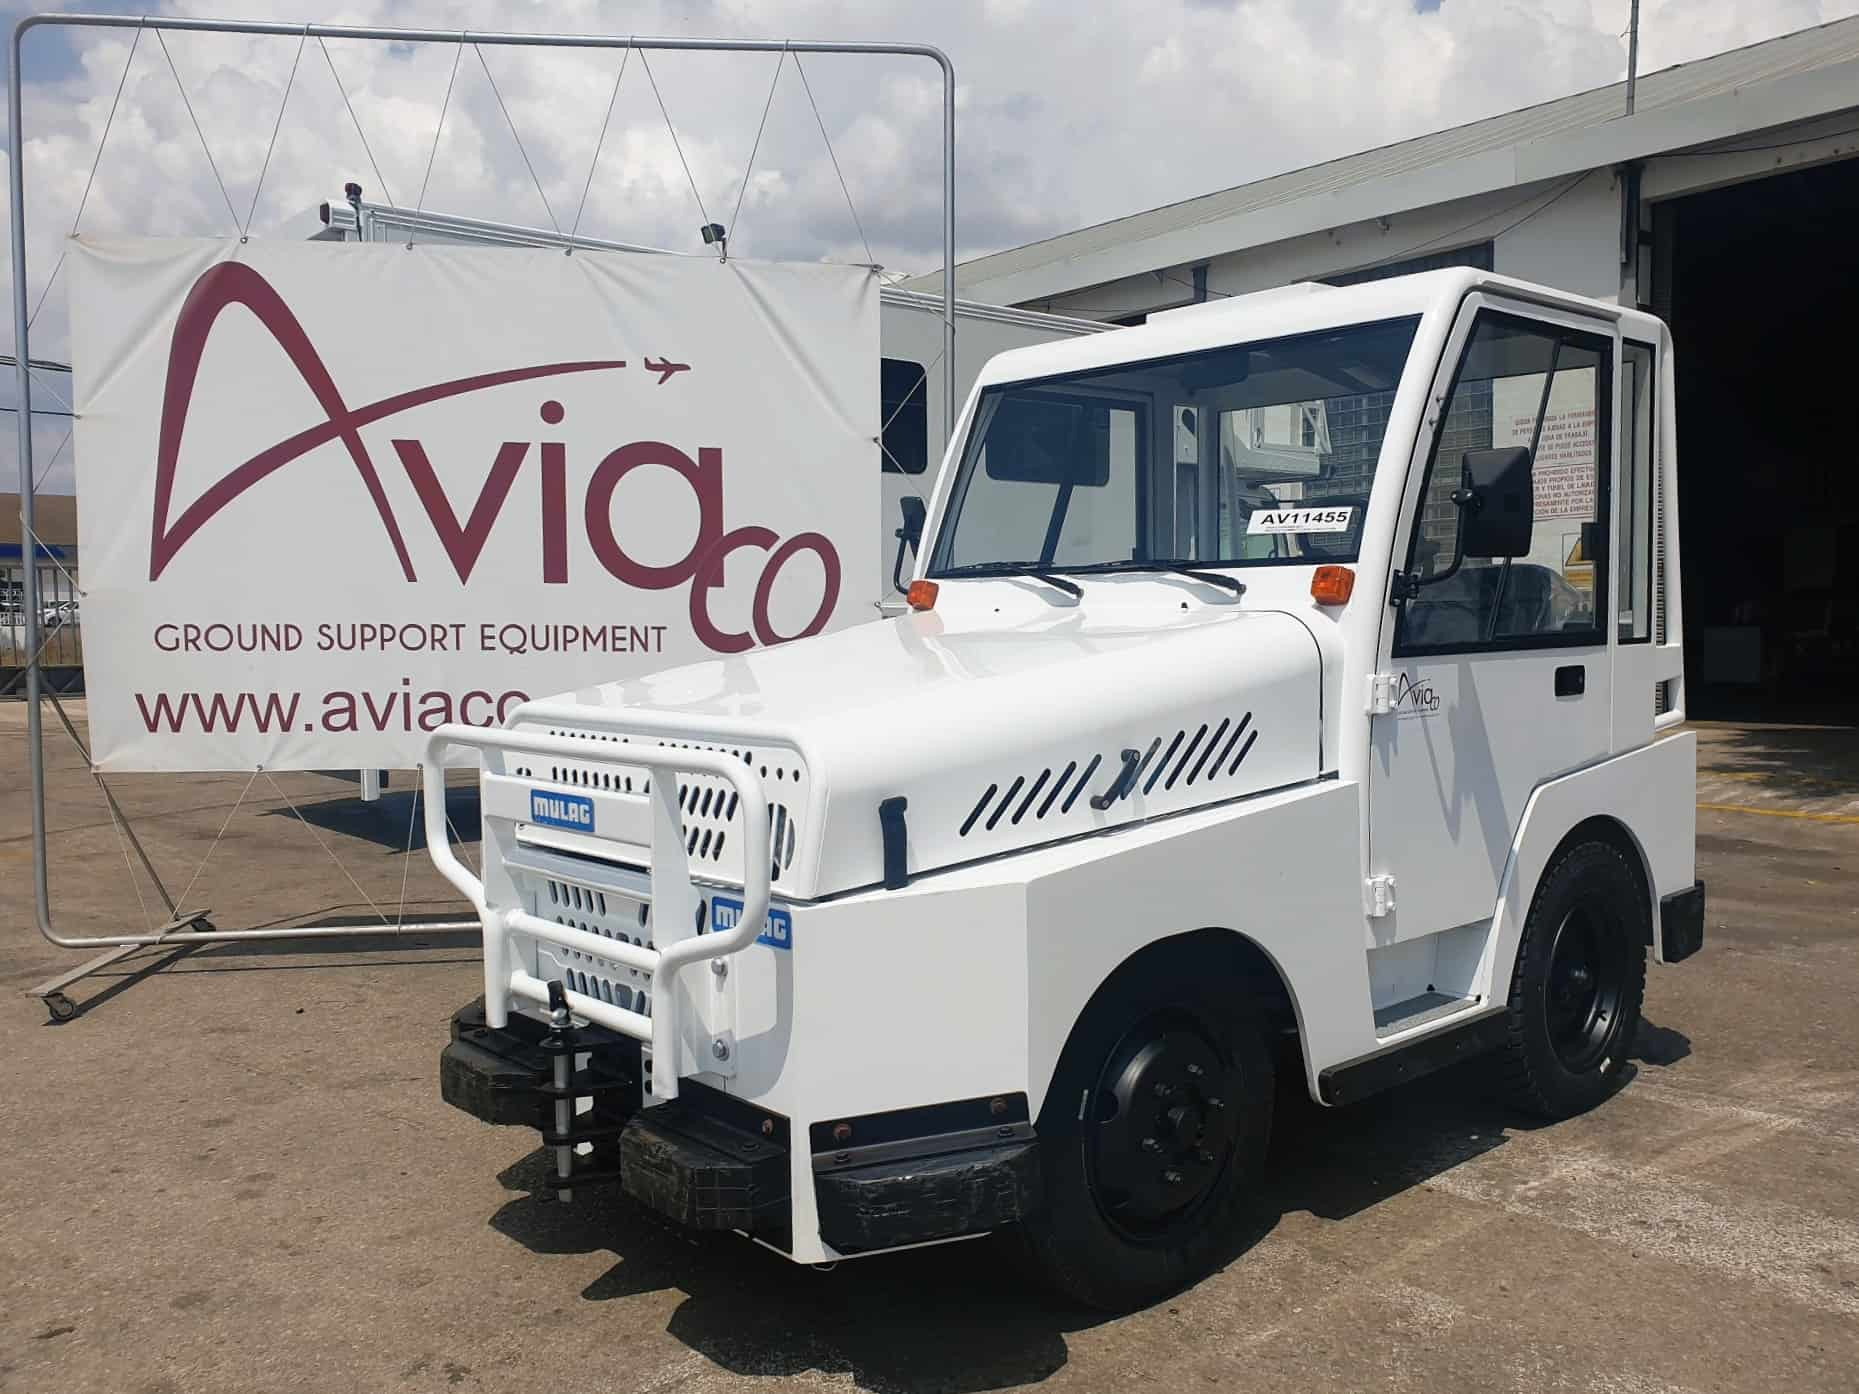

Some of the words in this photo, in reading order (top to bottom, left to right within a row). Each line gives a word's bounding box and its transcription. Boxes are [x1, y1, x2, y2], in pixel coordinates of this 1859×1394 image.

[1260, 511, 1349, 525] AV11455
[154, 623, 304, 653] GROUND
[316, 624, 468, 653] SUPPORT
[479, 625, 667, 656] EQUIPMENT
[533, 796, 590, 824] MULAG
